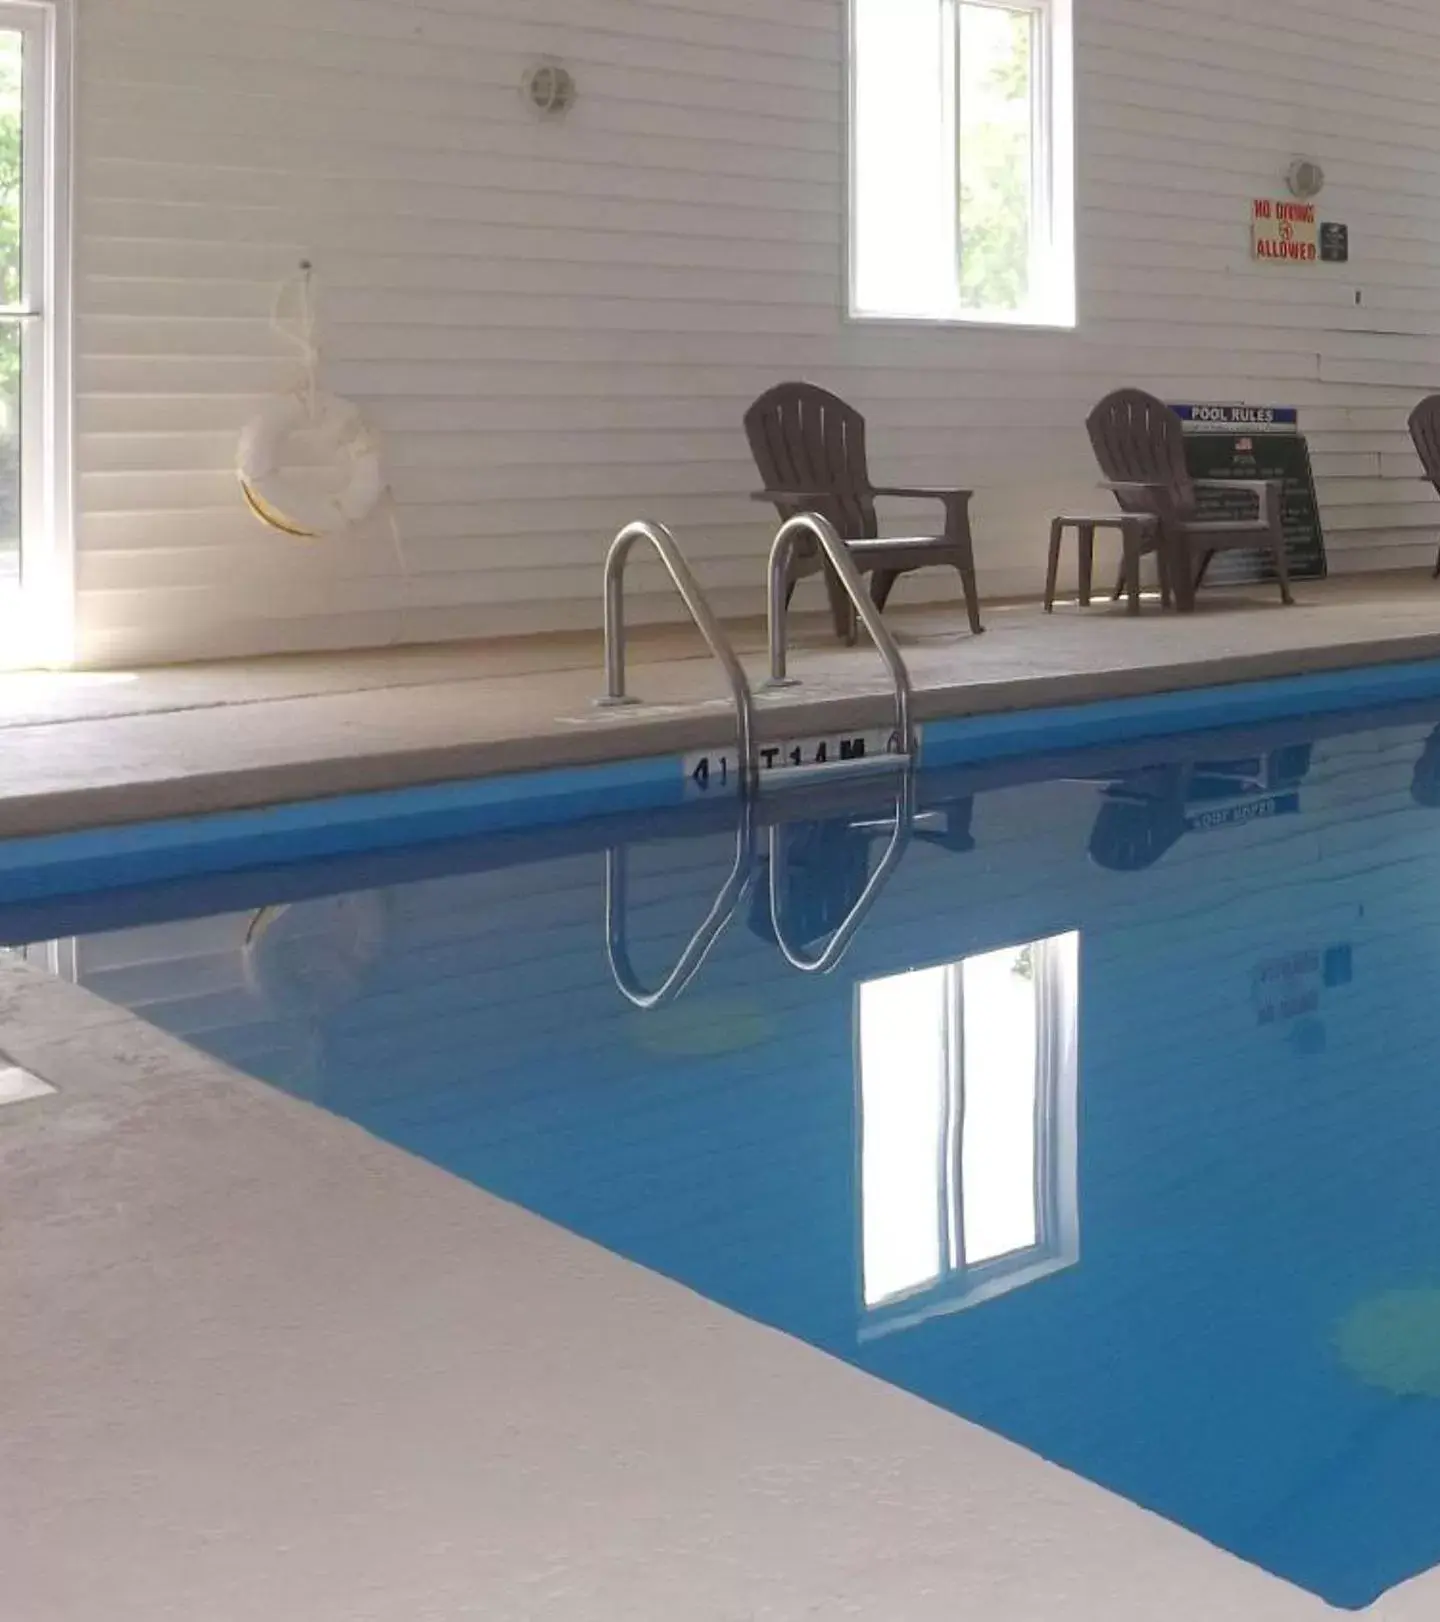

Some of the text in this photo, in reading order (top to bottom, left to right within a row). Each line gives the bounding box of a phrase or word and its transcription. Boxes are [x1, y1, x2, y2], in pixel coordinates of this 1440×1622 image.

[1254, 199, 1314, 223] NO DIVING
[1257, 239, 1316, 260] ALLOWED
[1192, 407, 1274, 422] POOL RULES
